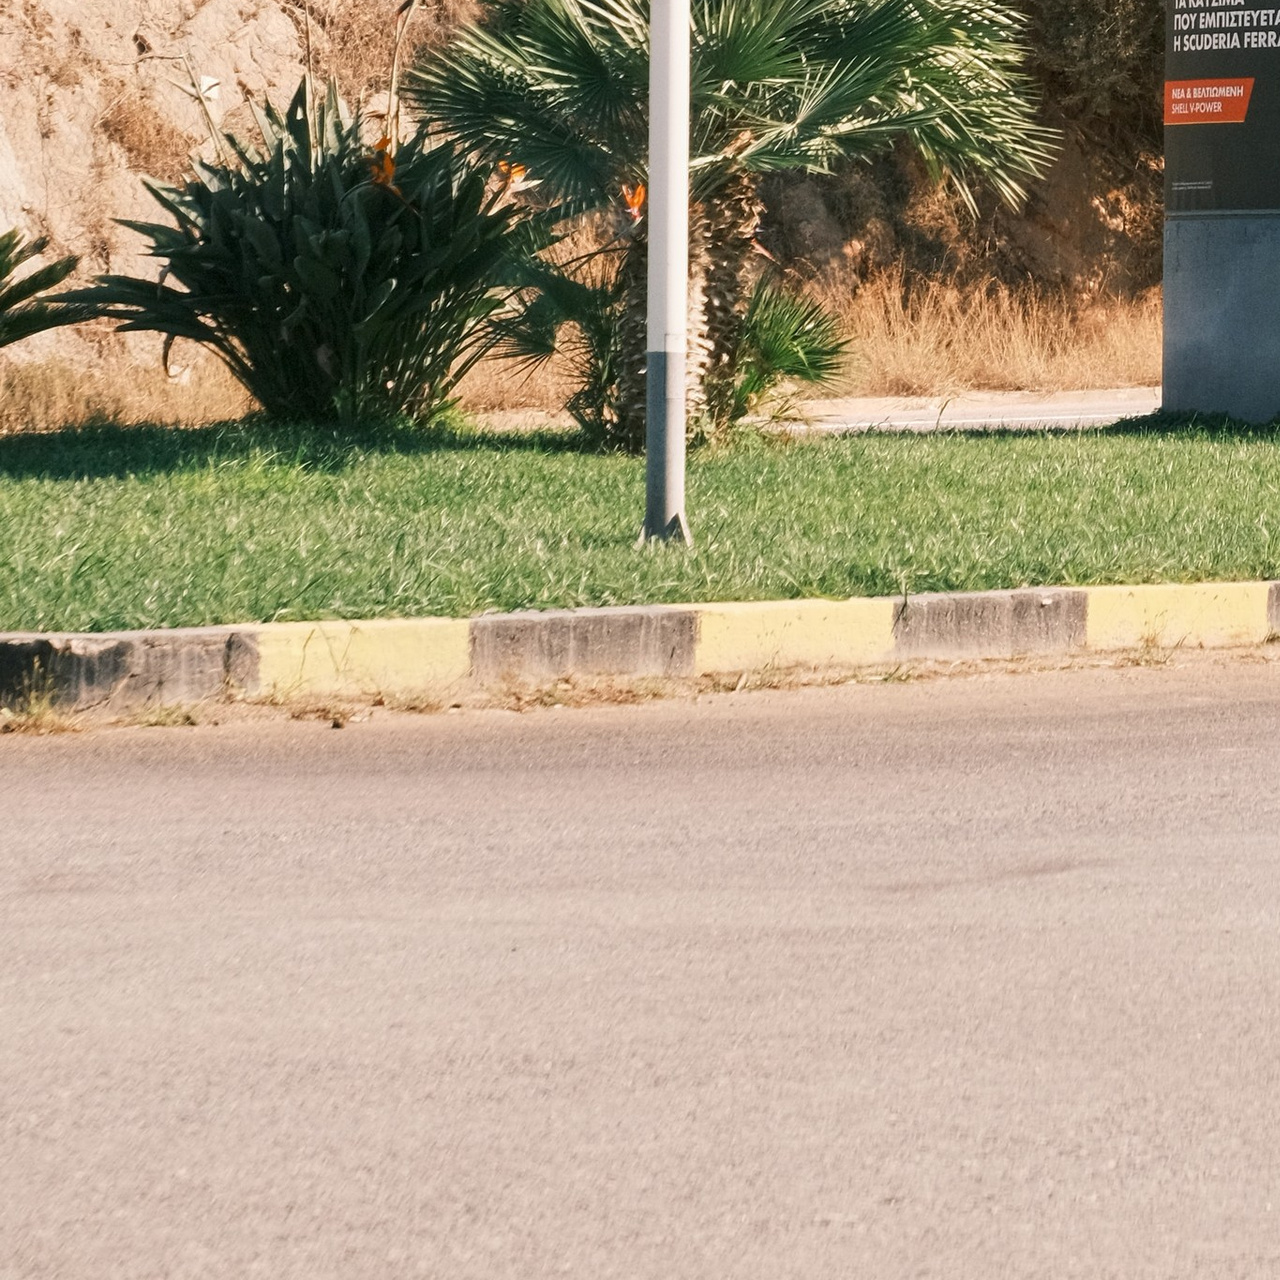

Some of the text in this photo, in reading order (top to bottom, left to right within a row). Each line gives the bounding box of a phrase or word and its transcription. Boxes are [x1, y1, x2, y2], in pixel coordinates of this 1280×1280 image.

[1174, 12, 1197, 30] ΠΟΥ
[1174, 35, 1181, 52] Η
[1183, 32, 1241, 52] SCUDERIA
[1171, 85, 1244, 100] ΝΕΑ & ΒΕΛΤΙΩΜΕΝΗ
[1171, 101, 1223, 114] SHELL V-POWER
